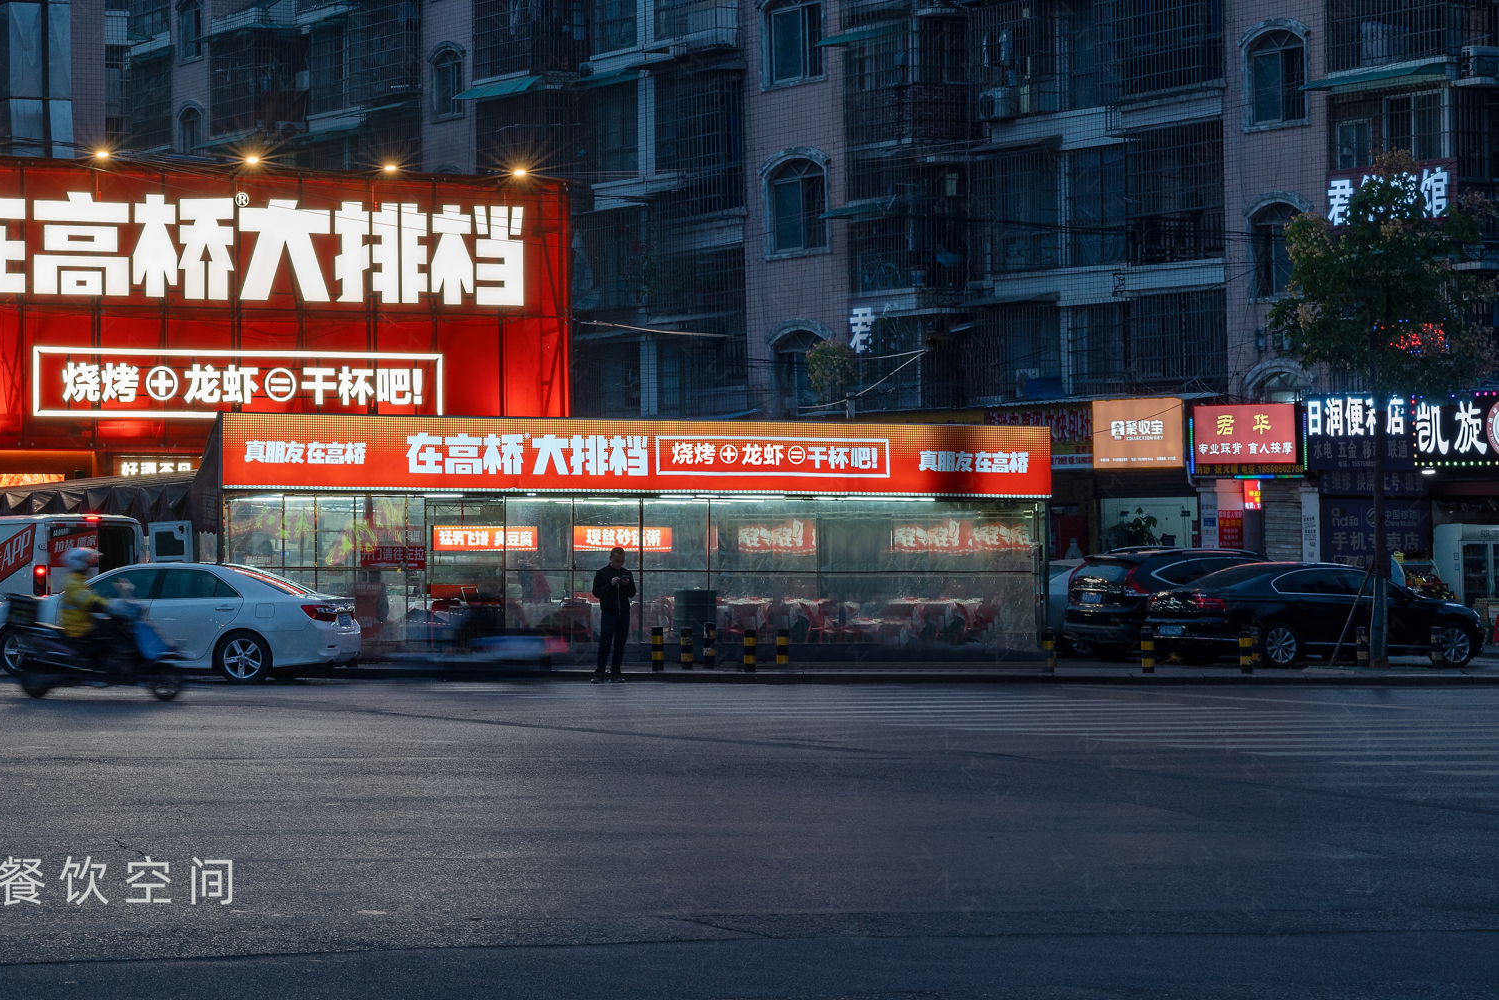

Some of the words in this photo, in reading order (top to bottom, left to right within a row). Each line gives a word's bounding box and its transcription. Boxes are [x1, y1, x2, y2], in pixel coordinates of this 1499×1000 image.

[1327, 166, 1449, 226] 君馆
[61, 361, 139, 405] 烧烤
[183, 362, 260, 406] 龙虾
[301, 364, 423, 407] 干杯吧!
[1125, 419, 1164, 436] 聚收宝
[1216, 413, 1272, 436] 君华
[1415, 401, 1488, 456] 凯旋
[406, 432, 649, 477] 在高桥大排档
[672, 442, 716, 466] 烧烤
[741, 443, 785, 467] 龙虾
[807, 446, 879, 470] 干杯吧!
[1198, 443, 1242, 455] 专业踩背
[1248, 442, 1293, 455] 盲人按摩
[1313, 440, 1333, 459] 水电
[1338, 440, 1357, 459] 五金
[1387, 440, 1408, 459] 联通
[439, 530, 489, 547] 猛男飞饼
[494, 530, 533, 547] 臭豆腐
[586, 528, 661, 547] 现熬砂锅粥
